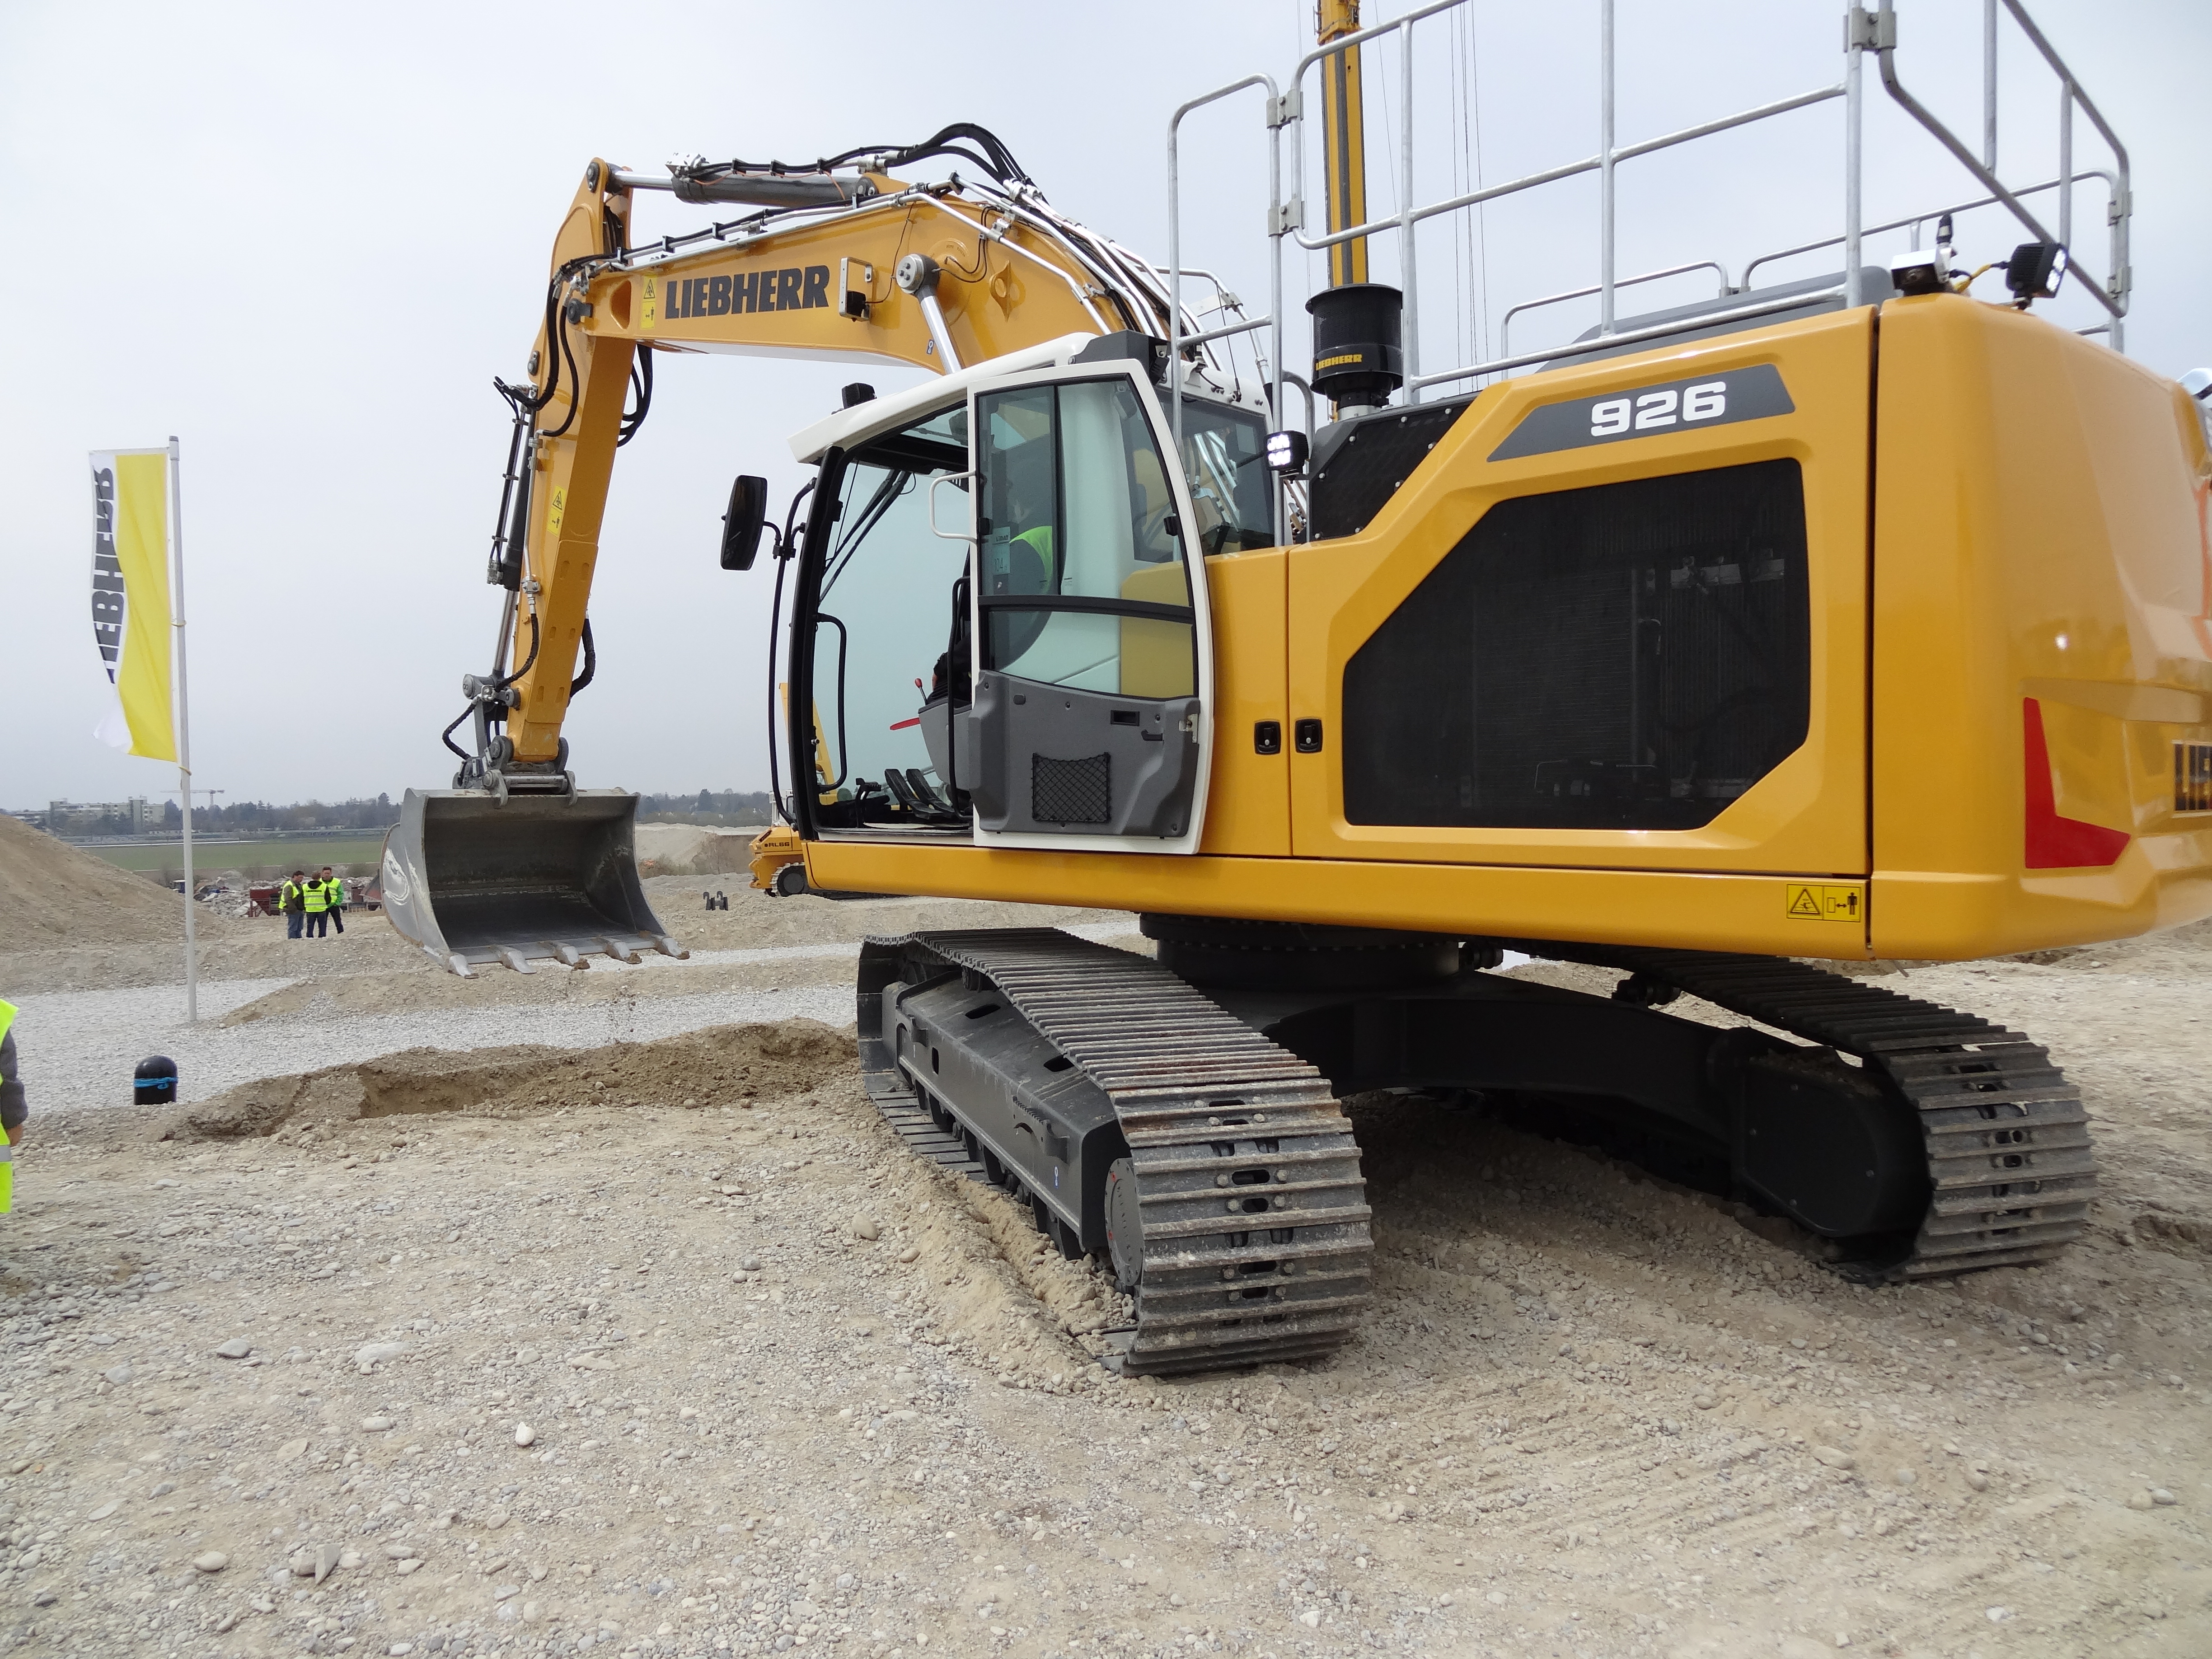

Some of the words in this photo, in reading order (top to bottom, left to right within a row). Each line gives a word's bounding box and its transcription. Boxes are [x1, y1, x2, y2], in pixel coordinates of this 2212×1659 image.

[665, 265, 830, 319] LIEBHERR
[1316, 354, 1363, 371] LIEBHERR
[1591, 381, 1726, 436] 926
[92, 464, 125, 684] IEBHERR
[2174, 744, 2212, 811] LIE
